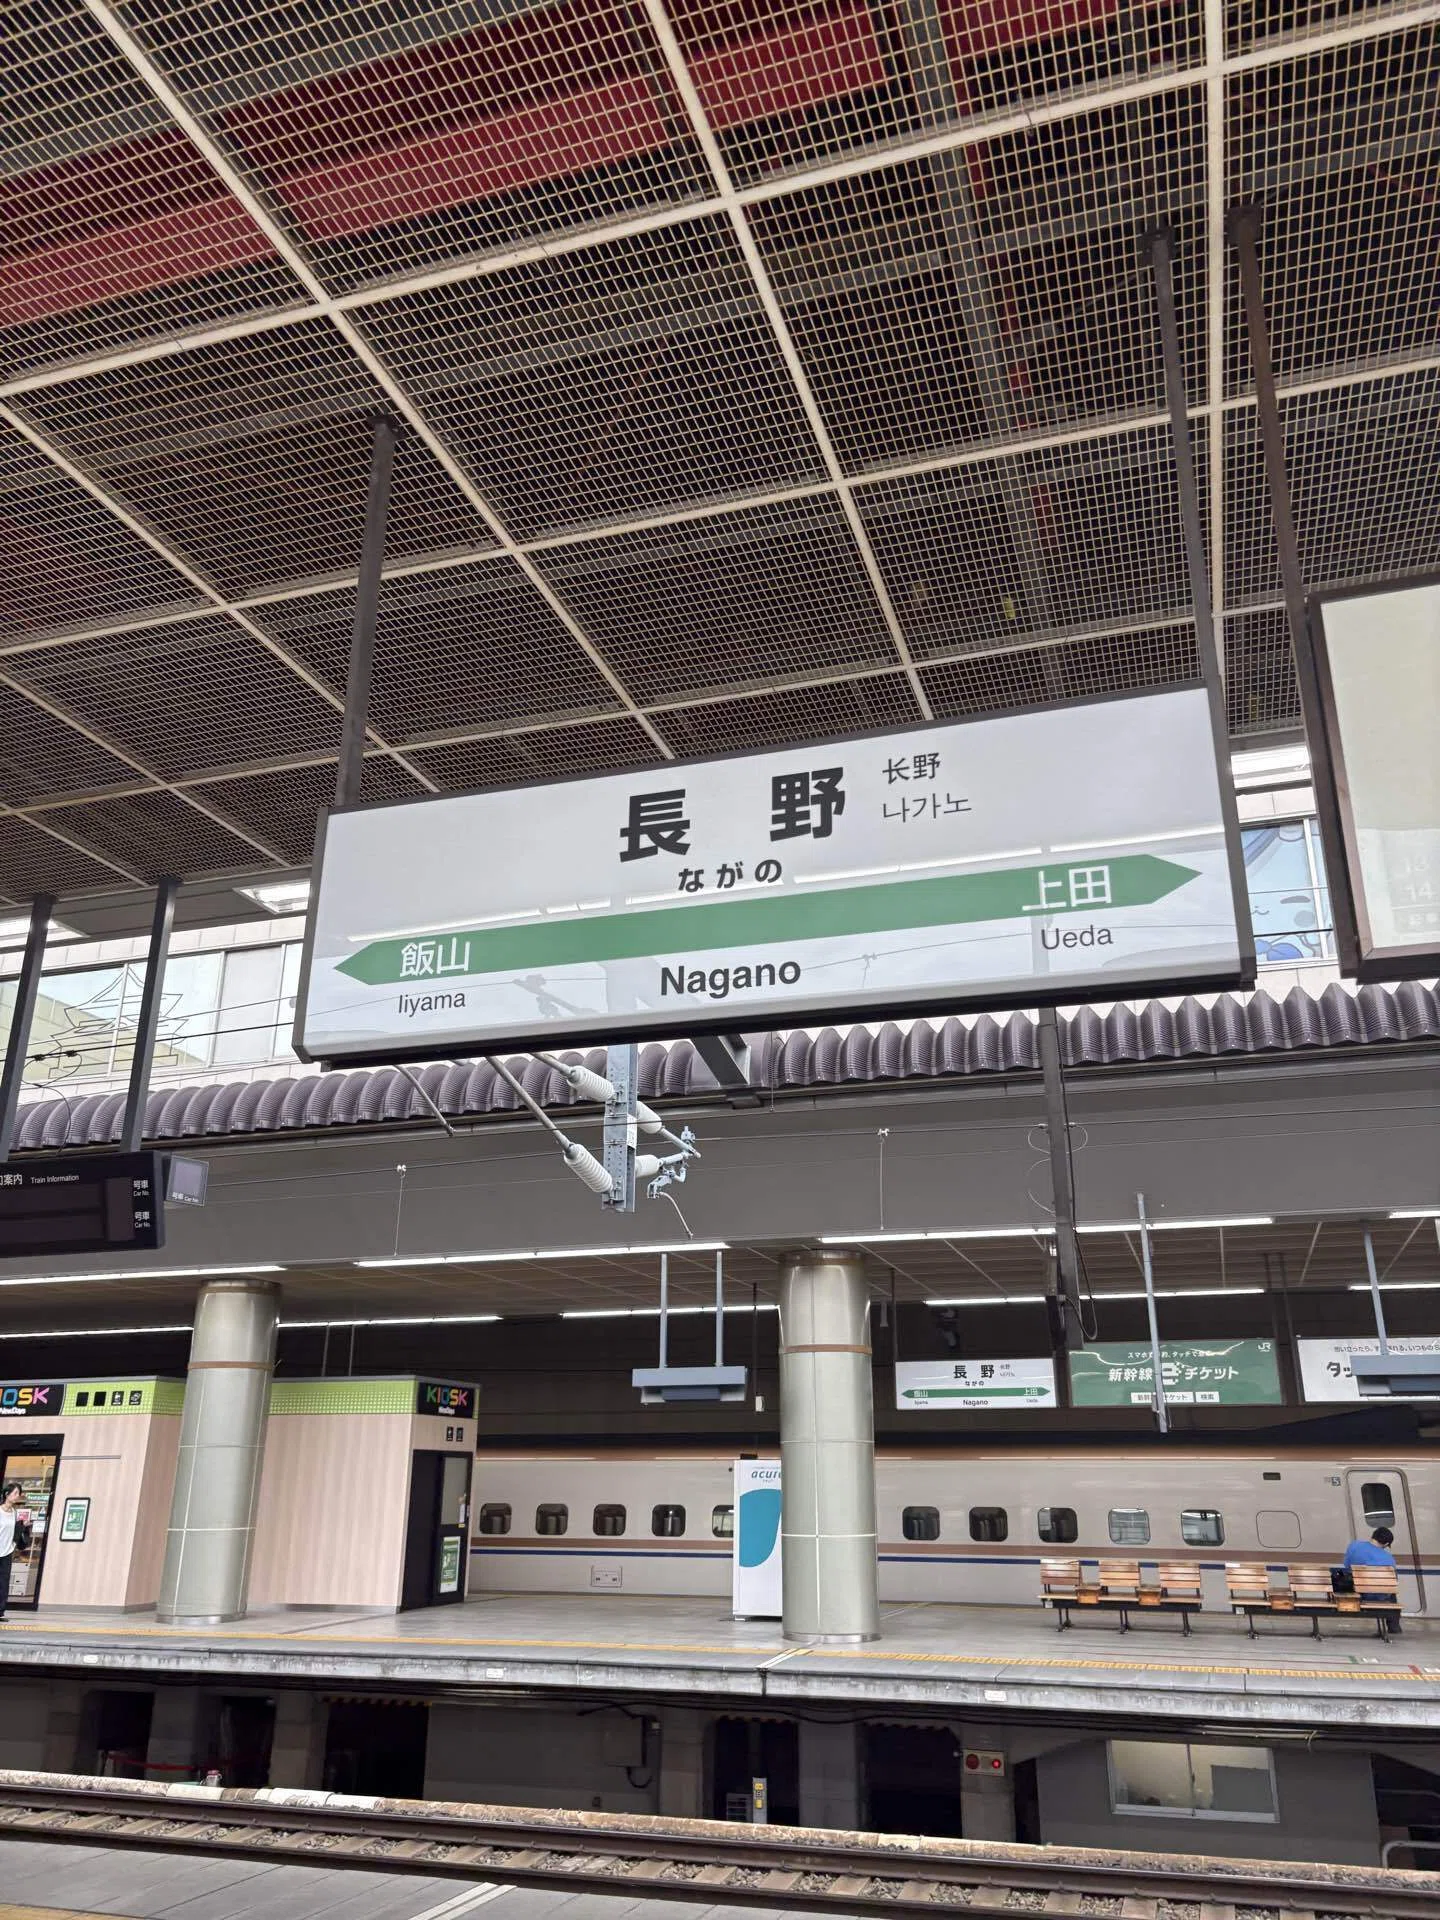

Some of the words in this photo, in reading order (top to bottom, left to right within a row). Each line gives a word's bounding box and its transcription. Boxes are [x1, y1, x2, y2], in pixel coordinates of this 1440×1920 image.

[882, 752, 940, 784] 长野
[620, 767, 846, 862] 長野
[882, 792, 972, 823] 나가노
[678, 859, 783, 893] ながの
[1022, 865, 1113, 911] 上田
[1041, 925, 1114, 951] Ueda
[399, 937, 471, 979] 飯山
[660, 960, 801, 999] Nagano
[397, 989, 467, 1018] Iiyama
[31, 1176, 46, 1184] Train
[1258, 1342, 1272, 1350] JR
[953, 1364, 995, 1379] 長野
[427, 1385, 468, 1407] KIOSK
